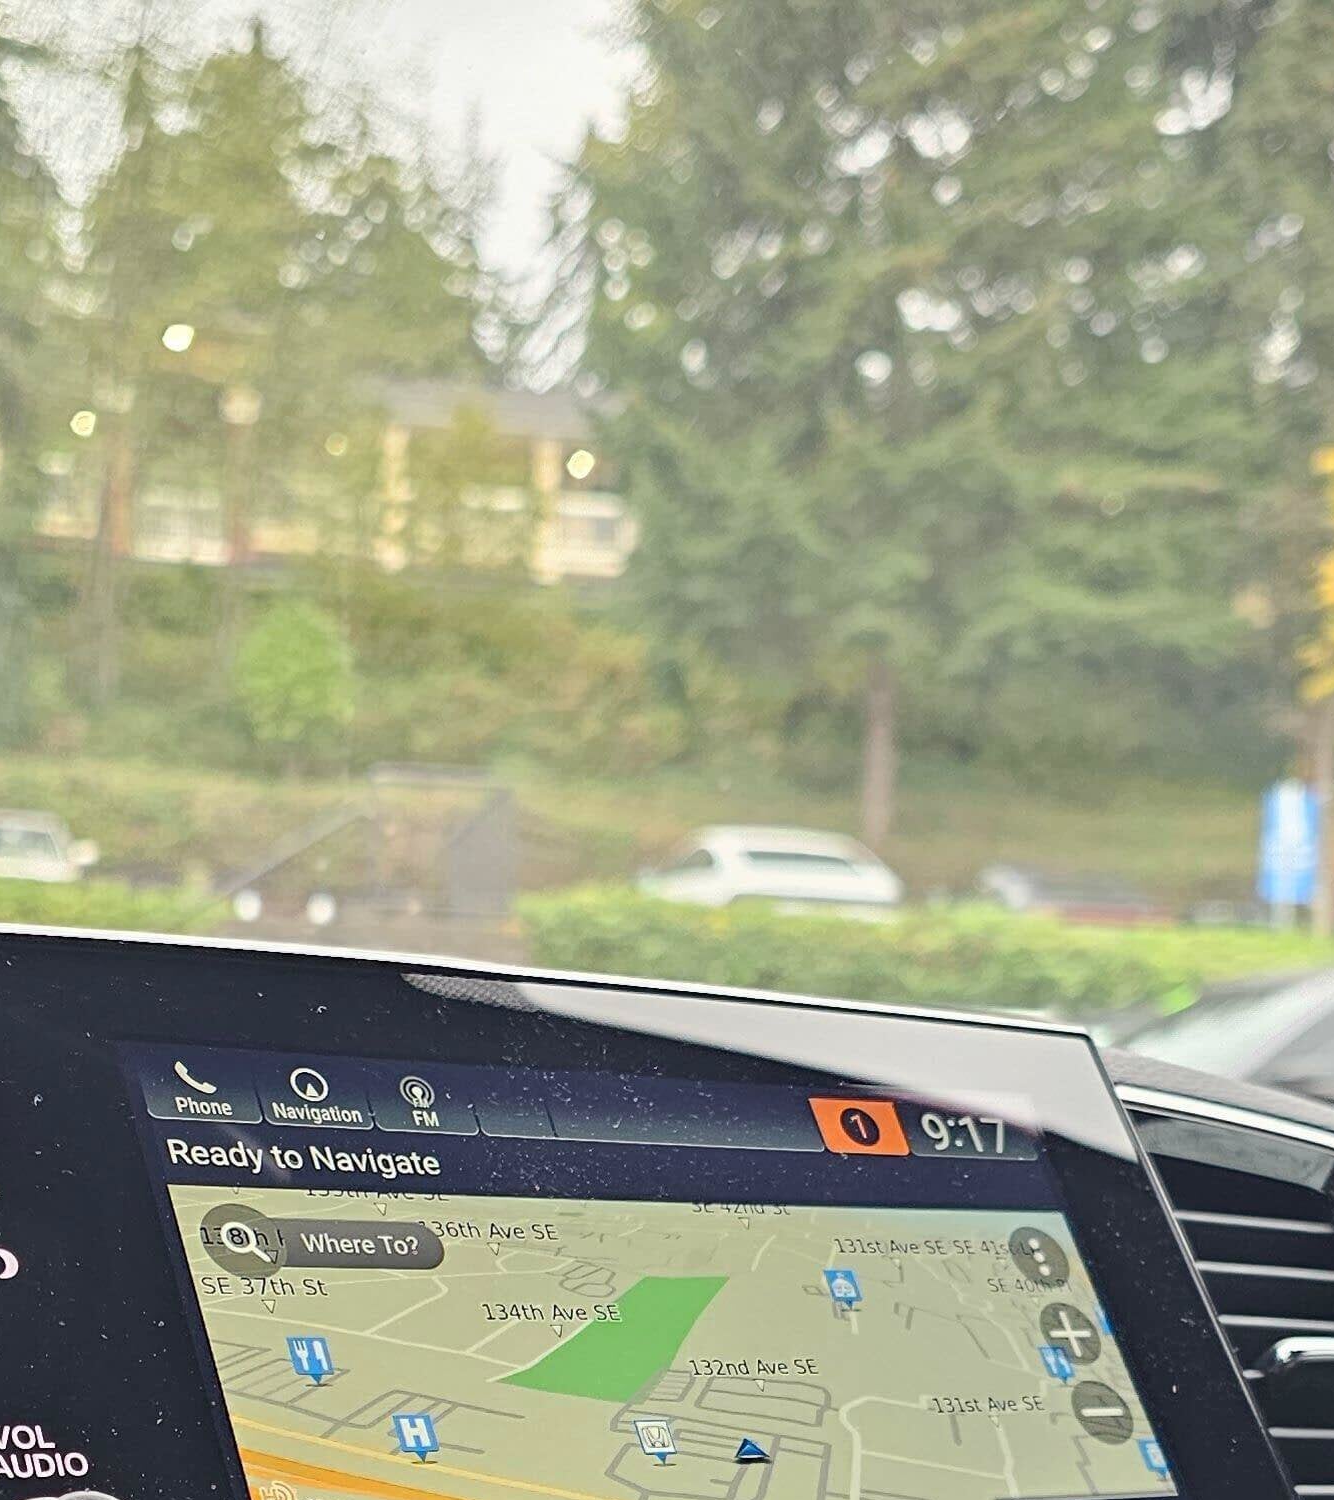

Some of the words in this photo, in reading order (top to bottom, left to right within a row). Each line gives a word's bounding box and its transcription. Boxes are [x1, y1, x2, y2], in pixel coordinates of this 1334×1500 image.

[173, 1096, 233, 1116] Phone
[272, 1102, 364, 1124] Navigation
[412, 1110, 440, 1127] FM
[921, 1112, 1004, 1154] 9:17
[166, 1138, 263, 1174] Ready
[271, 1145, 304, 1170] to
[309, 1146, 441, 1180] Navigate
[418, 1221, 481, 1239] 36th
[489, 1222, 525, 1240] Ave
[531, 1223, 559, 1241] SE
[300, 1232, 375, 1255] Where
[378, 1233, 418, 1256] To?
[834, 1239, 884, 1255] 131st
[890, 1239, 918, 1255] Ave
[923, 1239, 948, 1255] SE
[953, 1240, 976, 1255] SE
[201, 1277, 233, 1295] SE
[240, 1278, 295, 1296] 37th
[302, 1278, 328, 1296] St
[987, 1278, 1009, 1293] SE
[482, 1304, 545, 1321] 134th
[552, 1304, 588, 1321] Ave
[594, 1305, 621, 1322] SE
[689, 1359, 750, 1376] 132nd
[757, 1359, 789, 1375] Ave
[793, 1359, 819, 1375] SE
[932, 1397, 983, 1413] 131st
[988, 1397, 1019, 1412] Ave
[1022, 1395, 1046, 1411] SE
